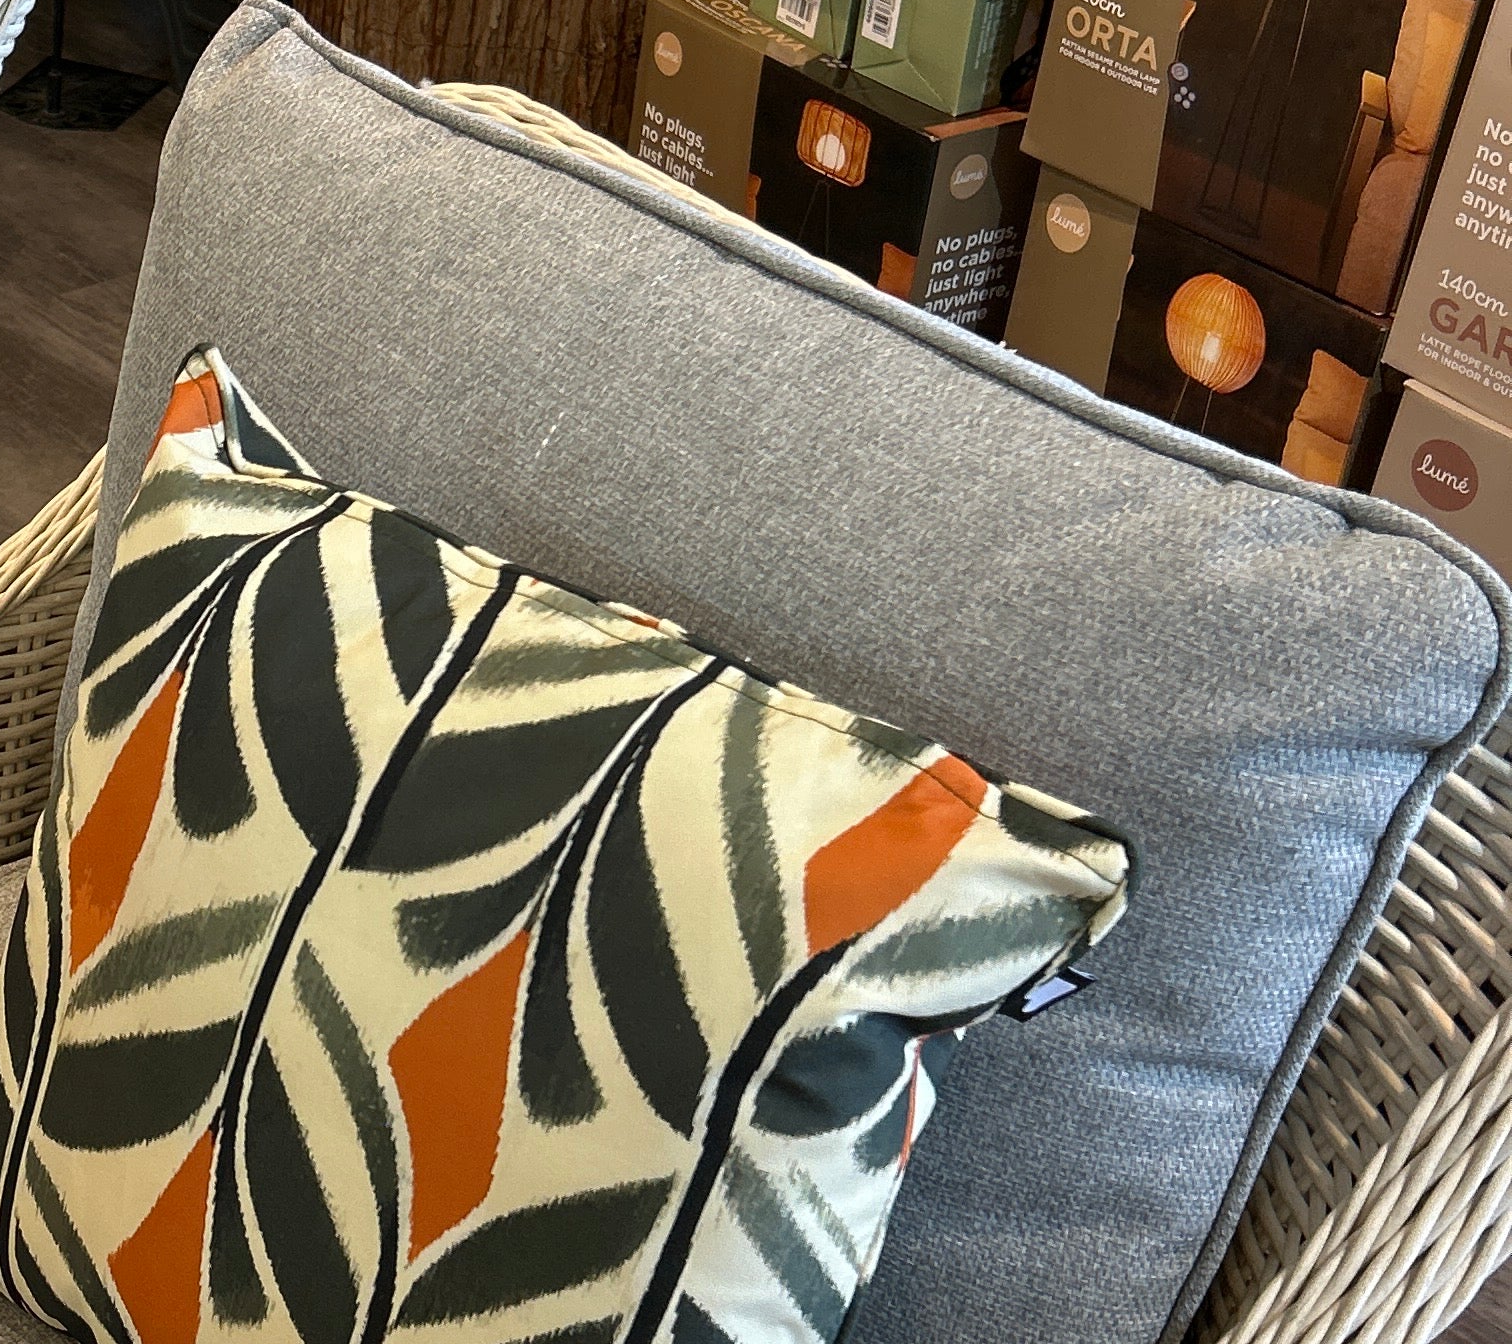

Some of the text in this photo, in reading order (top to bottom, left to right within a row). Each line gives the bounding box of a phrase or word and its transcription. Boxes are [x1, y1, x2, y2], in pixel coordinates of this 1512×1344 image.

[1066, 6, 1158, 71] ORTA
[1059, 46, 1074, 58] FOR
[1074, 54, 1101, 71] INDOOR
[1106, 68, 1143, 89] OUTDOOR
[1143, 84, 1158, 96] USE
[1061, 37, 1161, 85] RATTAN SESAME FLOOR LAMP
[644, 101, 706, 153] No plugs,
[638, 140, 697, 188] just light
[641, 124, 714, 178] no cables...
[1475, 144, 1503, 167] no
[1466, 163, 1508, 196] just
[935, 225, 1017, 255] No plugs,
[1050, 206, 1085, 237] lumé
[924, 263, 1006, 299] just light
[931, 257, 955, 275] no
[924, 284, 1011, 314] anywhere,
[1438, 268, 1509, 318] 140cm
[1417, 343, 1439, 361] FOR
[1440, 355, 1482, 382] INDOOR
[1420, 332, 1512, 387] LATTE ROPE FLOO
[1416, 453, 1470, 495] lumé
